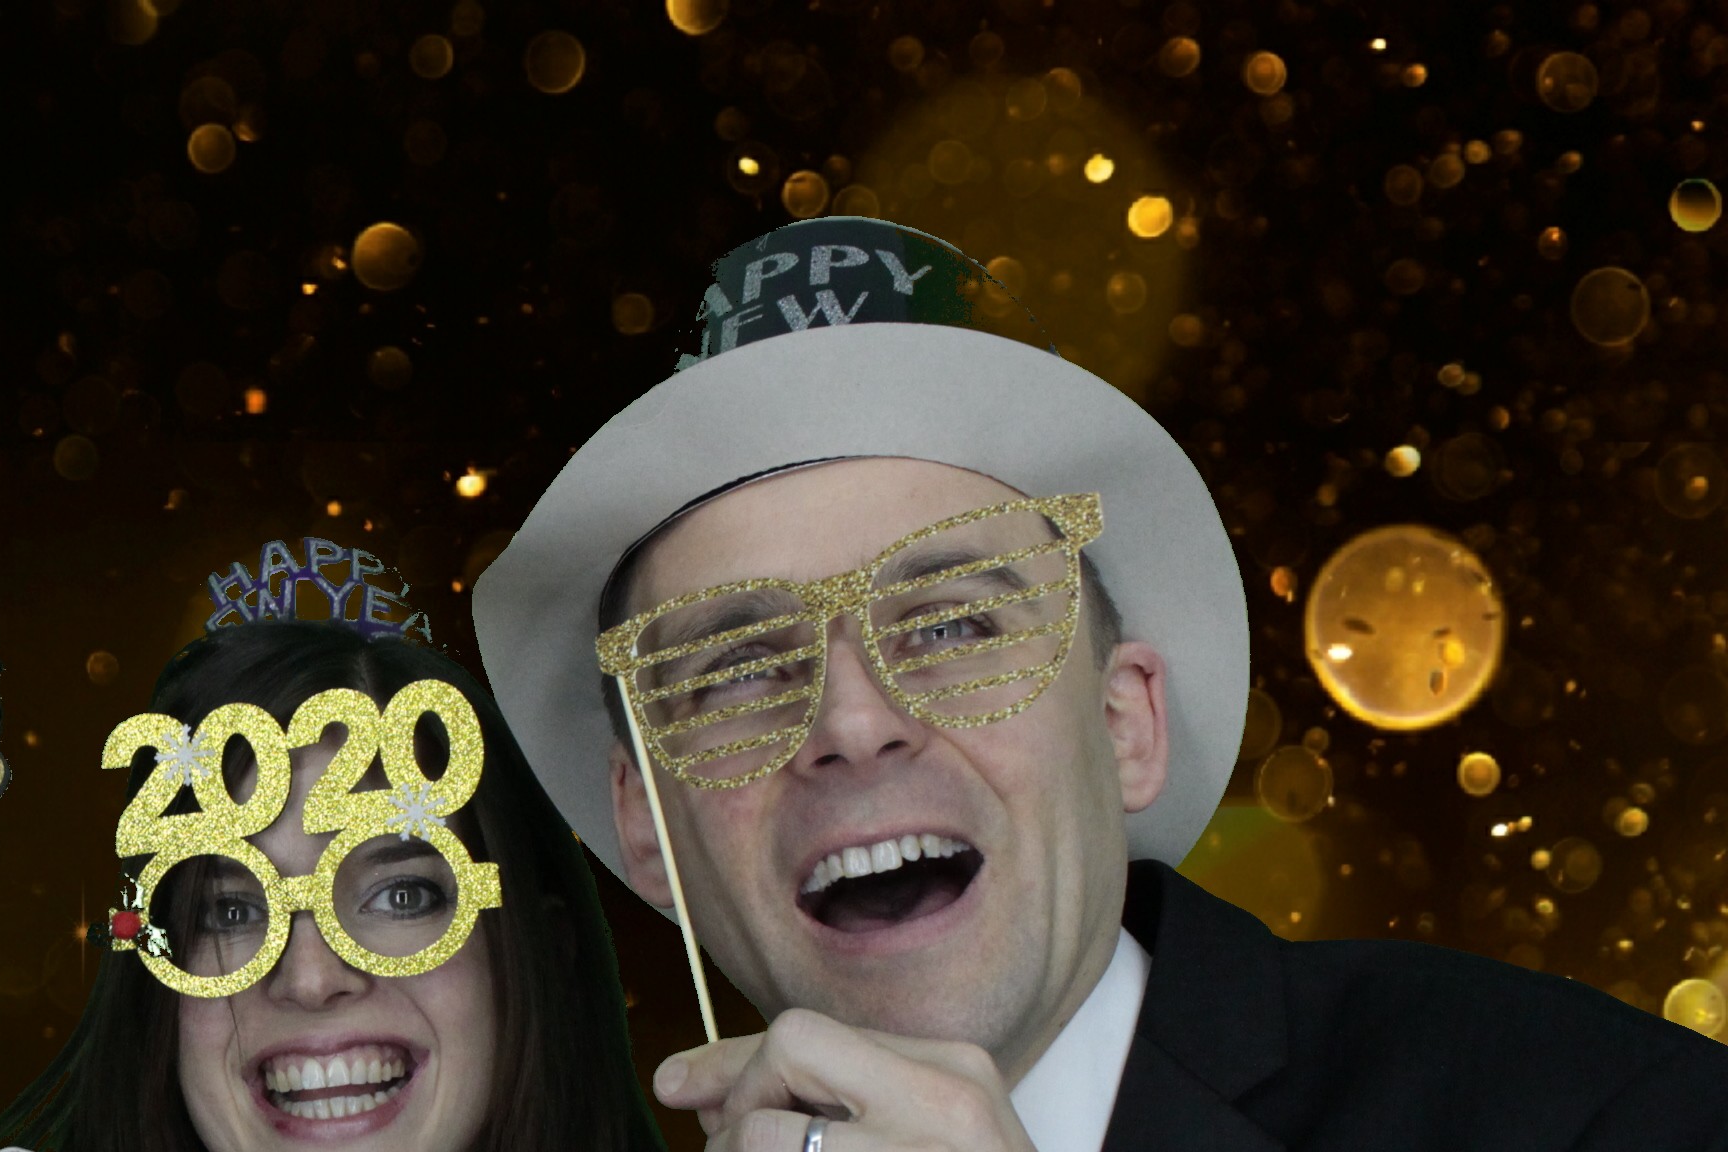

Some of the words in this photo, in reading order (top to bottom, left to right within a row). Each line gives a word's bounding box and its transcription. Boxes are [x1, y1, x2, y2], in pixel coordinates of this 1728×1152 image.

[696, 245, 932, 320] APPY
[208, 537, 411, 604] HAPP
[312, 573, 433, 643] YEA
[101, 679, 484, 857] 2020
